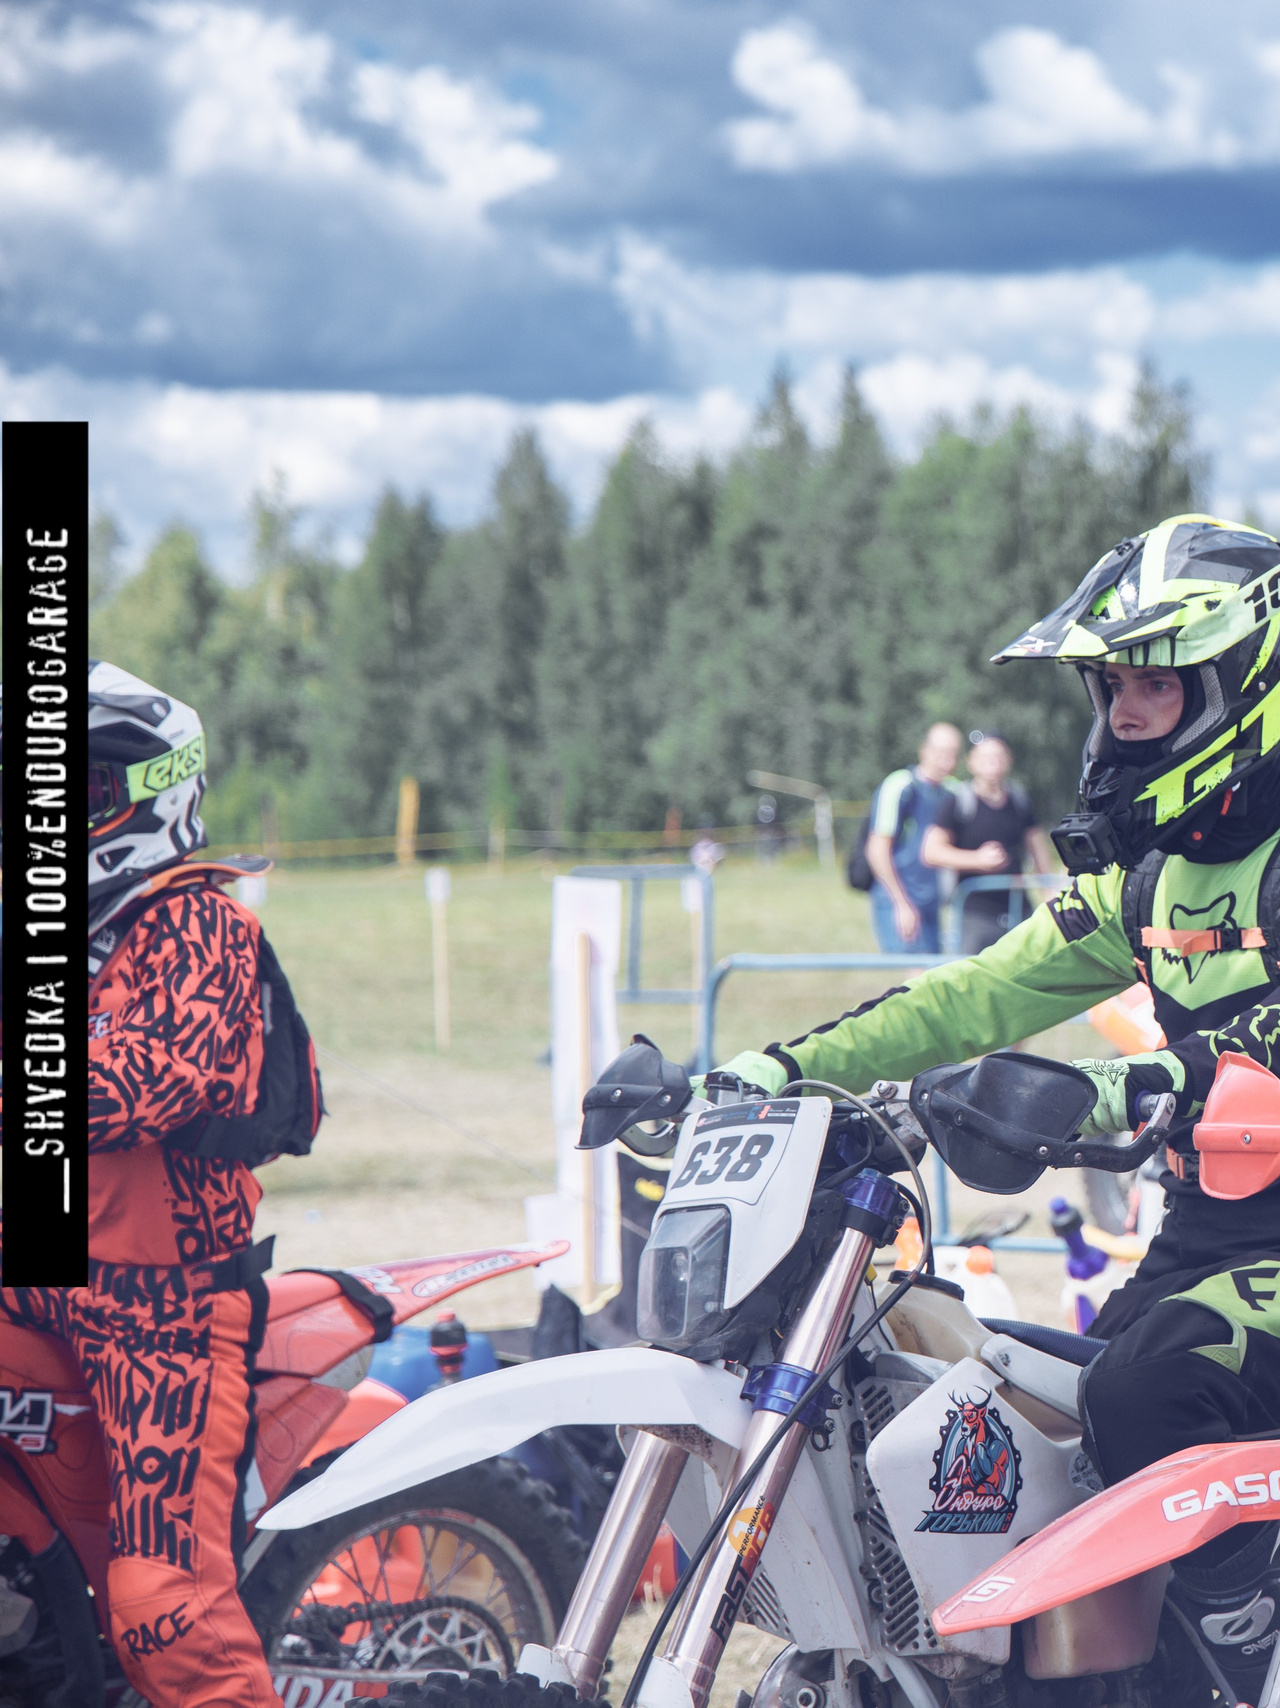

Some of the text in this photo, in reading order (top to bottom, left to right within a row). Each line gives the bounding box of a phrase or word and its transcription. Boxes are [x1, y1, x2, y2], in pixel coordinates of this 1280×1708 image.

[670, 1133, 775, 1190] 638
[739, 1495, 766, 1557] PERFORMANCE
[120, 1601, 195, 1662] RACE
